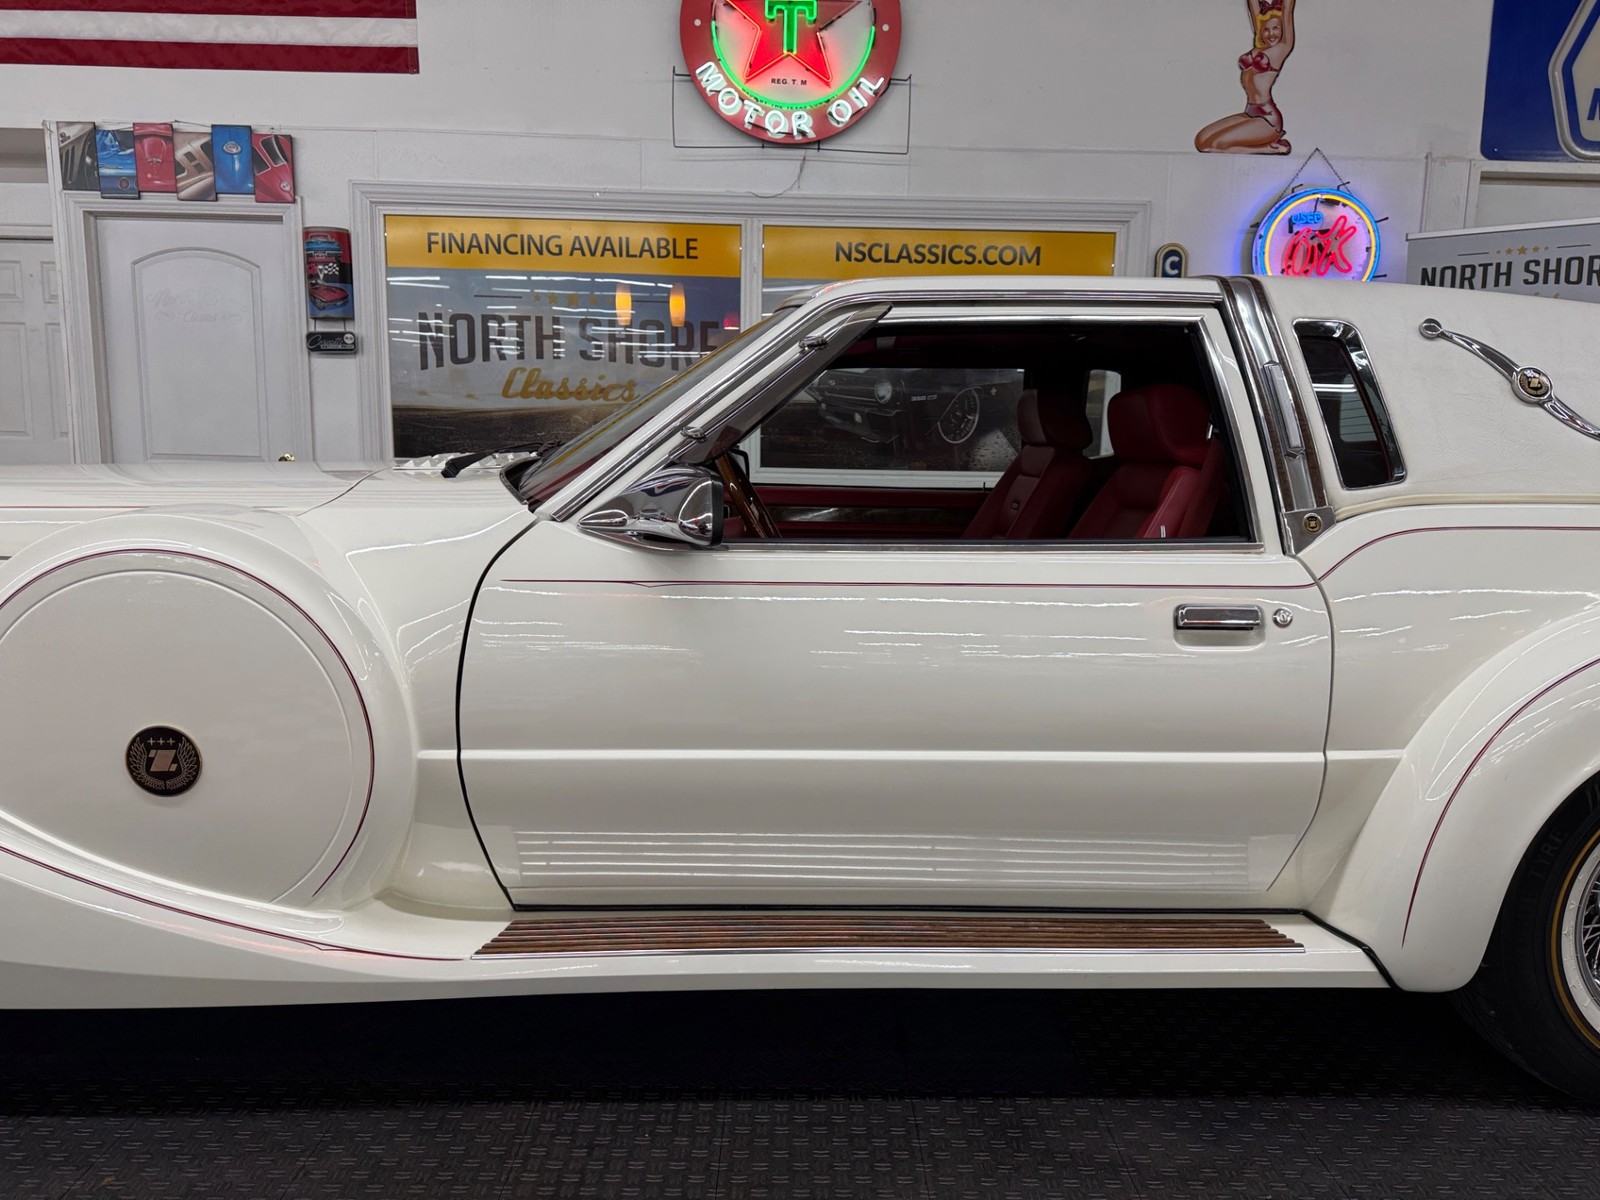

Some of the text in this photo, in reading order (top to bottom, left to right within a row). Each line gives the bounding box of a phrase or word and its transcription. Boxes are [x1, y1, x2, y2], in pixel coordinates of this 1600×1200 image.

[695, 61, 885, 140] MOTOR OIL
[1291, 211, 1324, 225] USED
[427, 232, 699, 260] FINANCING AVAILABLE
[835, 241, 1042, 267] NSCLASSICS.COM
[1284, 215, 1357, 277] OK
[1420, 261, 1513, 290] NORTH
[418, 311, 719, 371] NORTH SHORE
[502, 366, 641, 402] Classics
